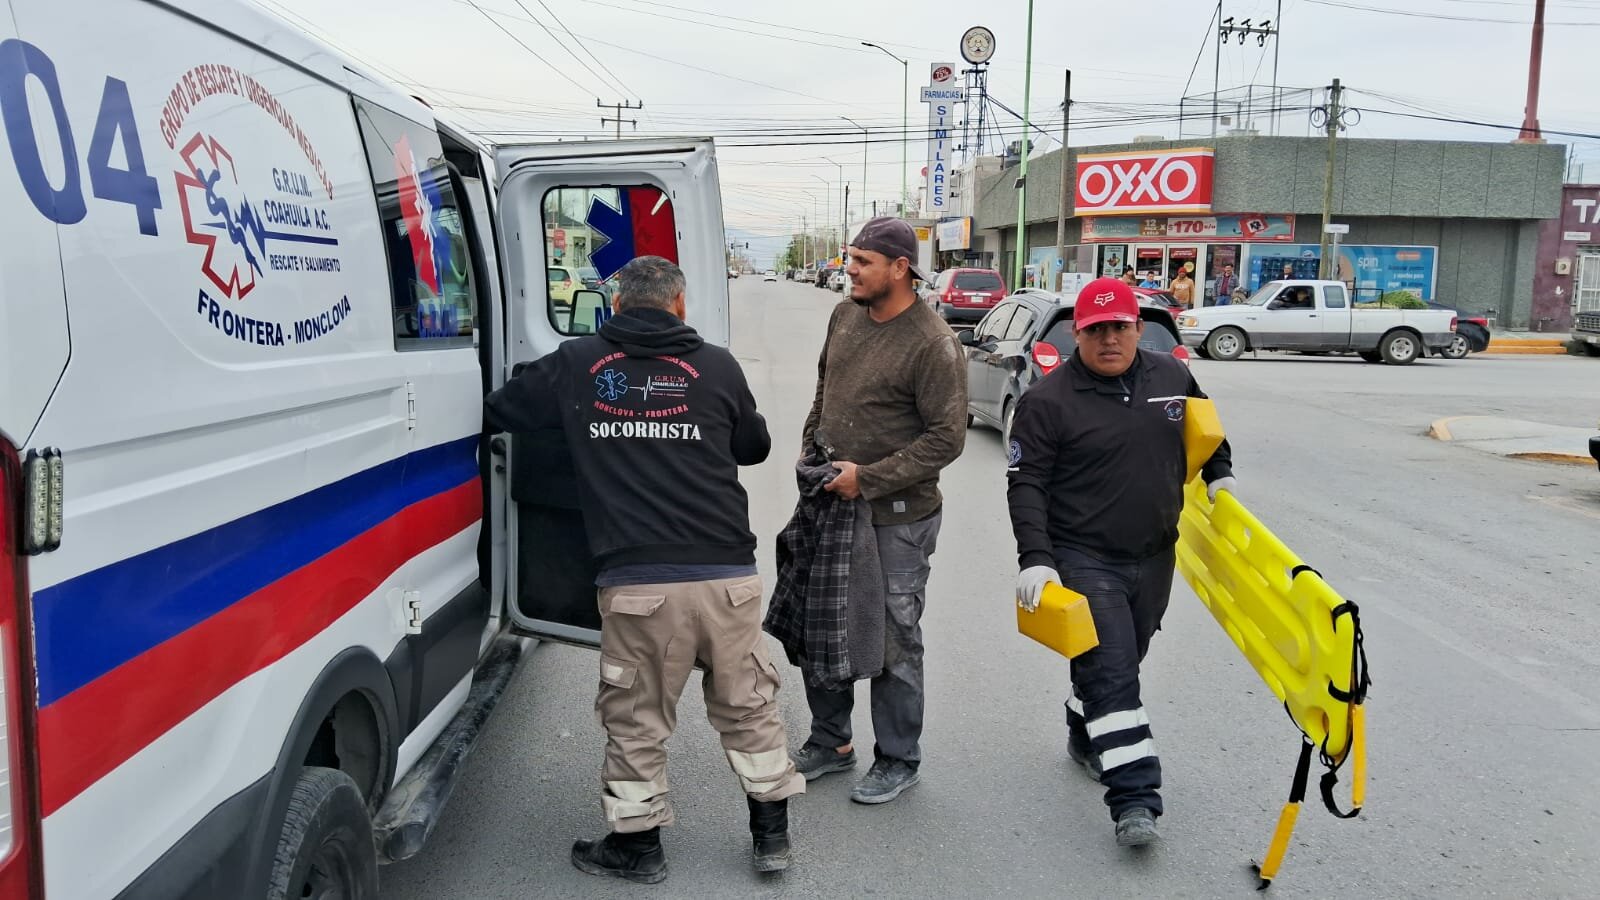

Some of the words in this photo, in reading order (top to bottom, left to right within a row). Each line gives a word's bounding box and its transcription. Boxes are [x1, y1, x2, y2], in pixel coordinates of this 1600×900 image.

[924, 90, 960, 99] FARMACIAS
[0, 38, 163, 236] 04
[159, 82, 190, 150] GRUPO
[182, 70, 202, 106] DE
[194, 63, 239, 98] RESCATE
[234, 68, 245, 98] Y
[242, 72, 296, 139] URGENCIAS
[295, 123, 334, 200] MEDICAS
[933, 105, 947, 207] SIMILARES
[272, 167, 313, 198] G.R.U.M.
[1079, 157, 1198, 207] OXXO
[263, 199, 312, 228] COAHUILA
[314, 207, 331, 231] A.C.
[269, 254, 300, 271] RESCATE
[299, 256, 304, 271] Y
[304, 256, 341, 273] SALVAMENTO
[1358, 256, 1379, 270] spin
[197, 288, 285, 346] FRONTERA
[294, 294, 352, 344] MONCLOVA
[594, 400, 634, 417] MONCLOVA
[645, 403, 689, 418] FRONTERA
[589, 421, 702, 441] SOCORRISTA
